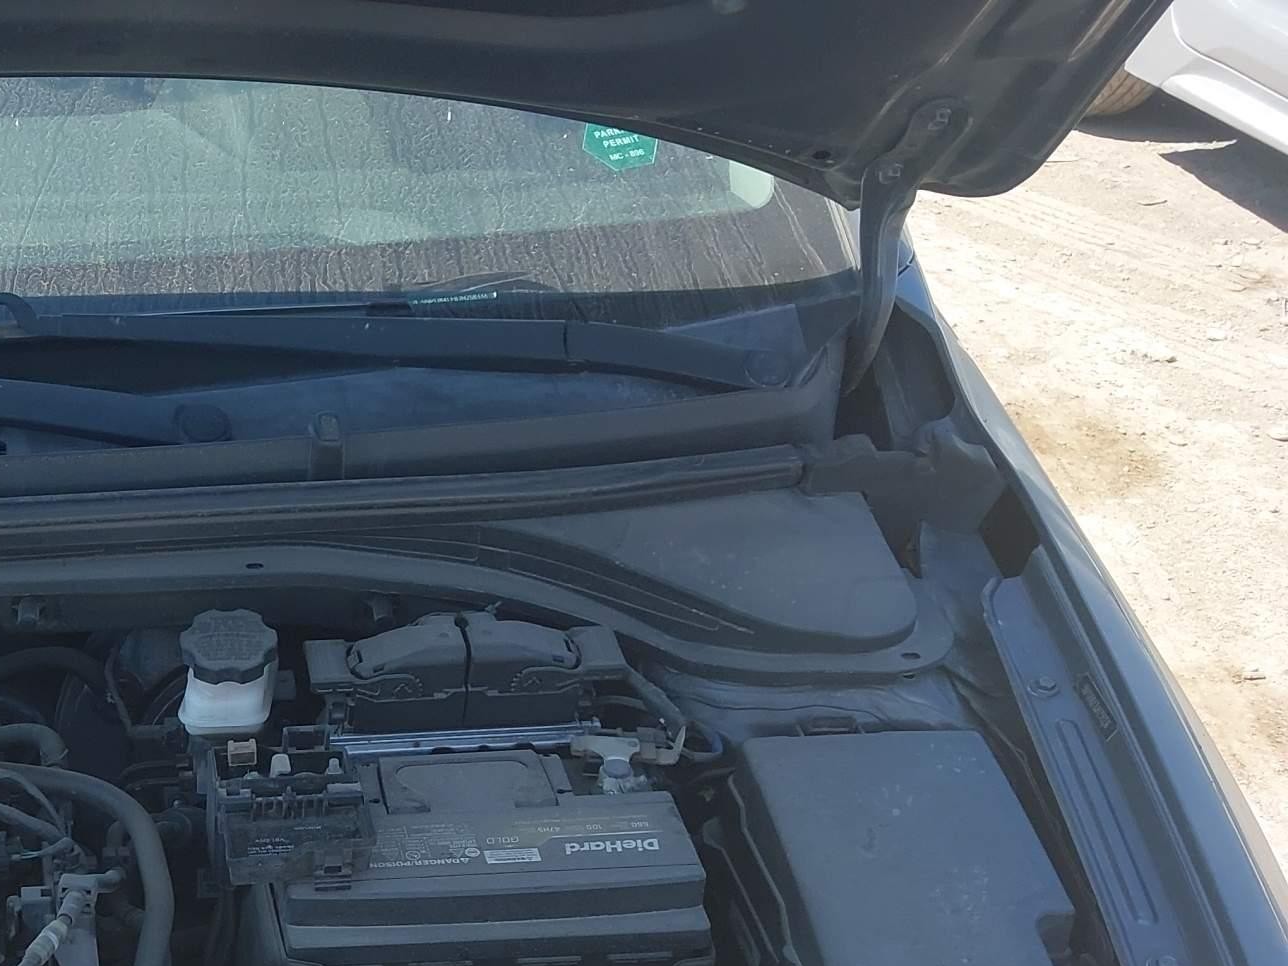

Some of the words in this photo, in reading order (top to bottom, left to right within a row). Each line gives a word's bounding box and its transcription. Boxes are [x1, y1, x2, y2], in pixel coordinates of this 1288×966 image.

[603, 134, 640, 148] PERMIT
[608, 152, 625, 161] MC
[486, 835, 520, 844] GOLD
[564, 837, 661, 855] DieHard
